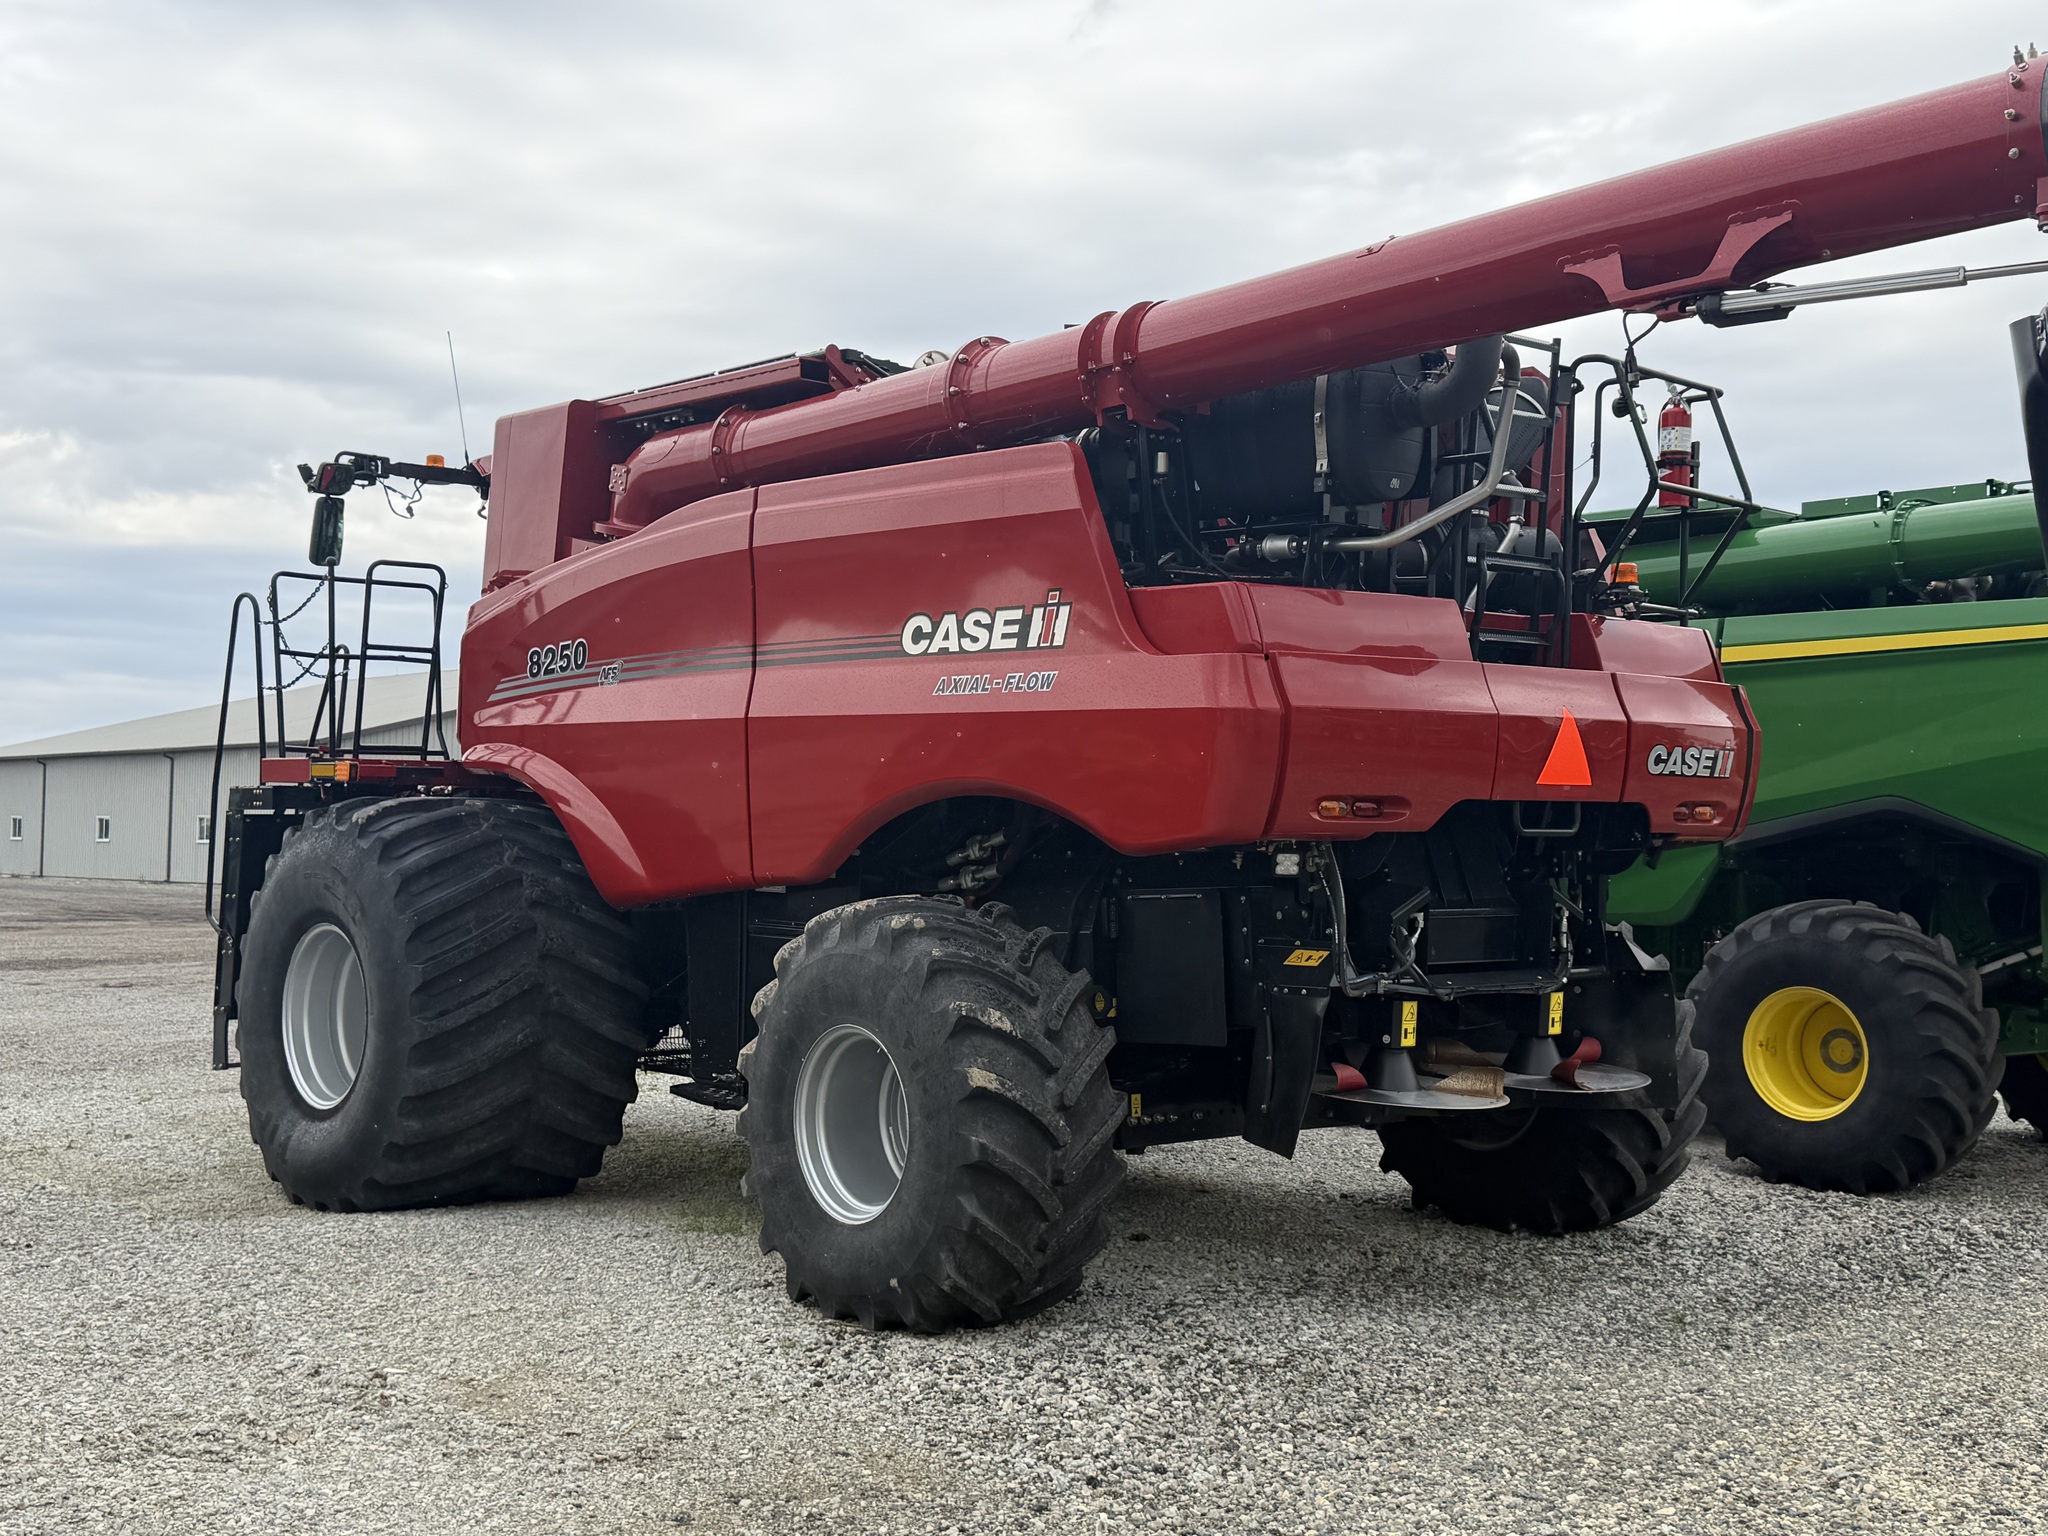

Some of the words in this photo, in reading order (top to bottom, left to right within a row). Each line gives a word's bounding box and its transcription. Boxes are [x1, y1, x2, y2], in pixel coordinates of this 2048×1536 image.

[902, 608, 1024, 655] CASE
[527, 638, 588, 680] 8250
[599, 665, 619, 681] AFS
[932, 671, 1059, 696] AXIAL-FLOW
[1647, 744, 1715, 777] CASE
